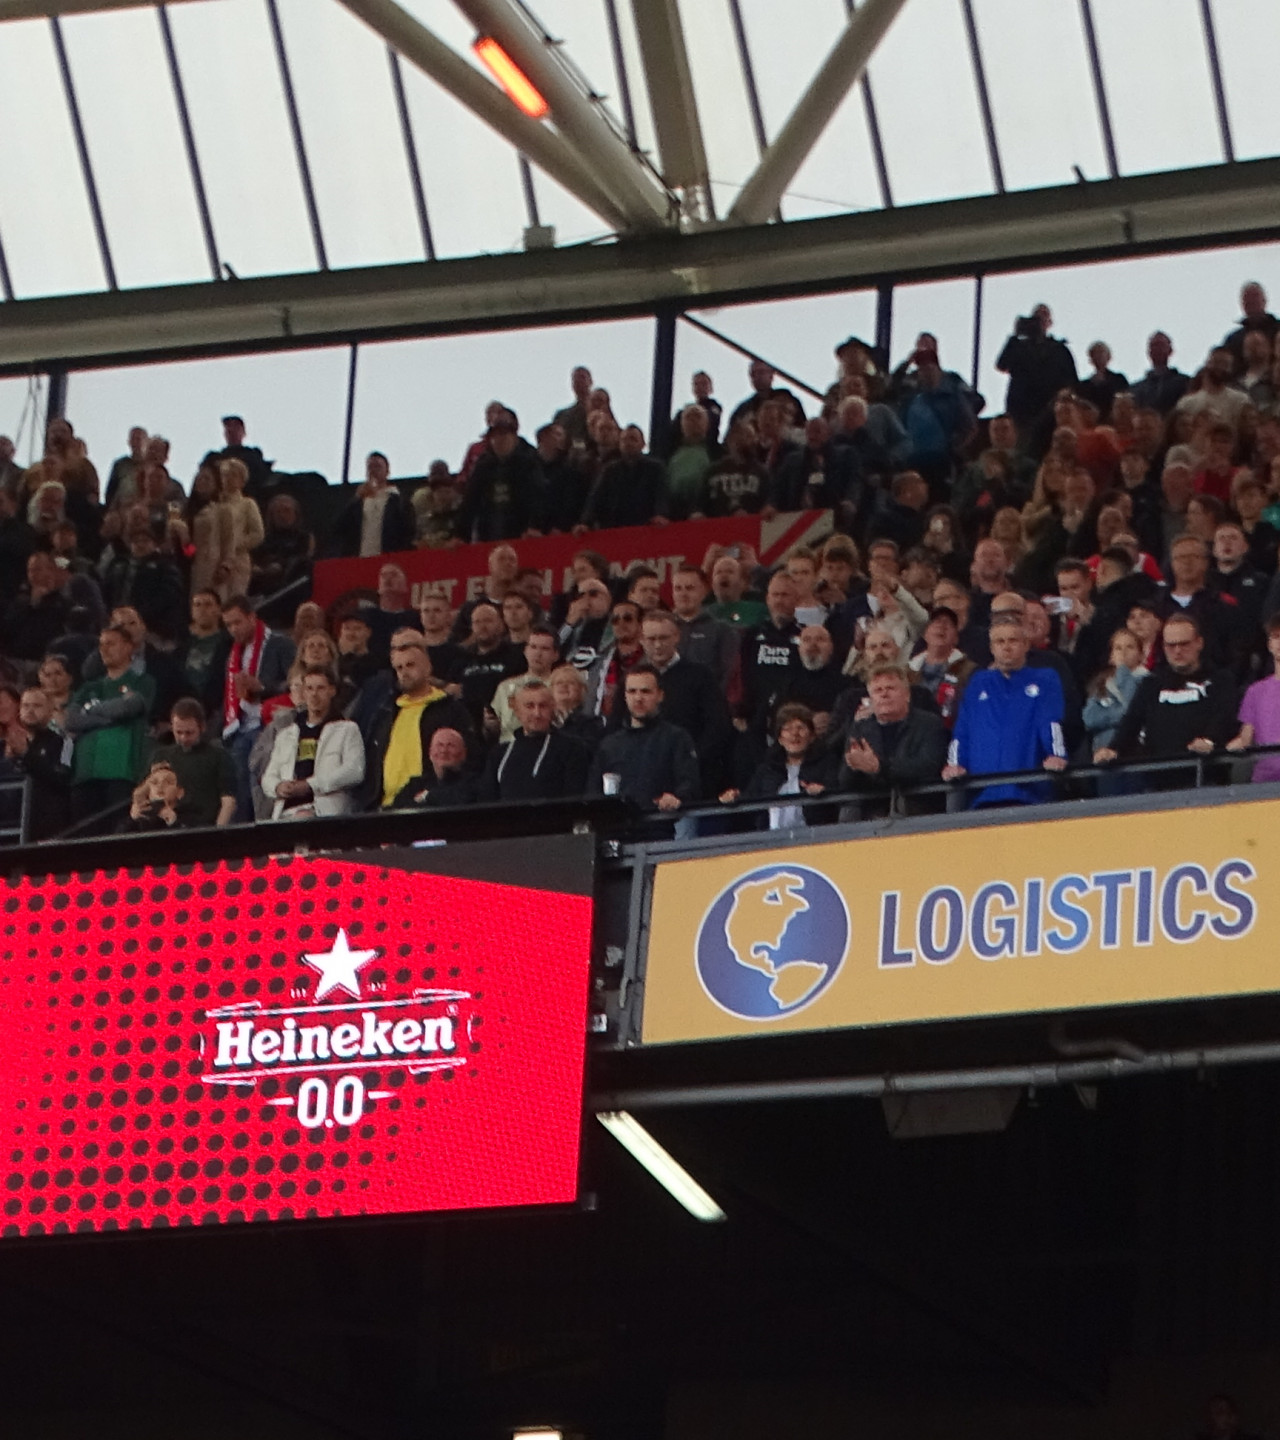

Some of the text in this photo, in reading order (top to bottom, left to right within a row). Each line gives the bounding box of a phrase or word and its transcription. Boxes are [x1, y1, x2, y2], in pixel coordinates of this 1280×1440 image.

[878, 857, 1258, 969] LOGISTICS
[214, 1012, 456, 1066] Heineken
[297, 1075, 364, 1128] 0.0
